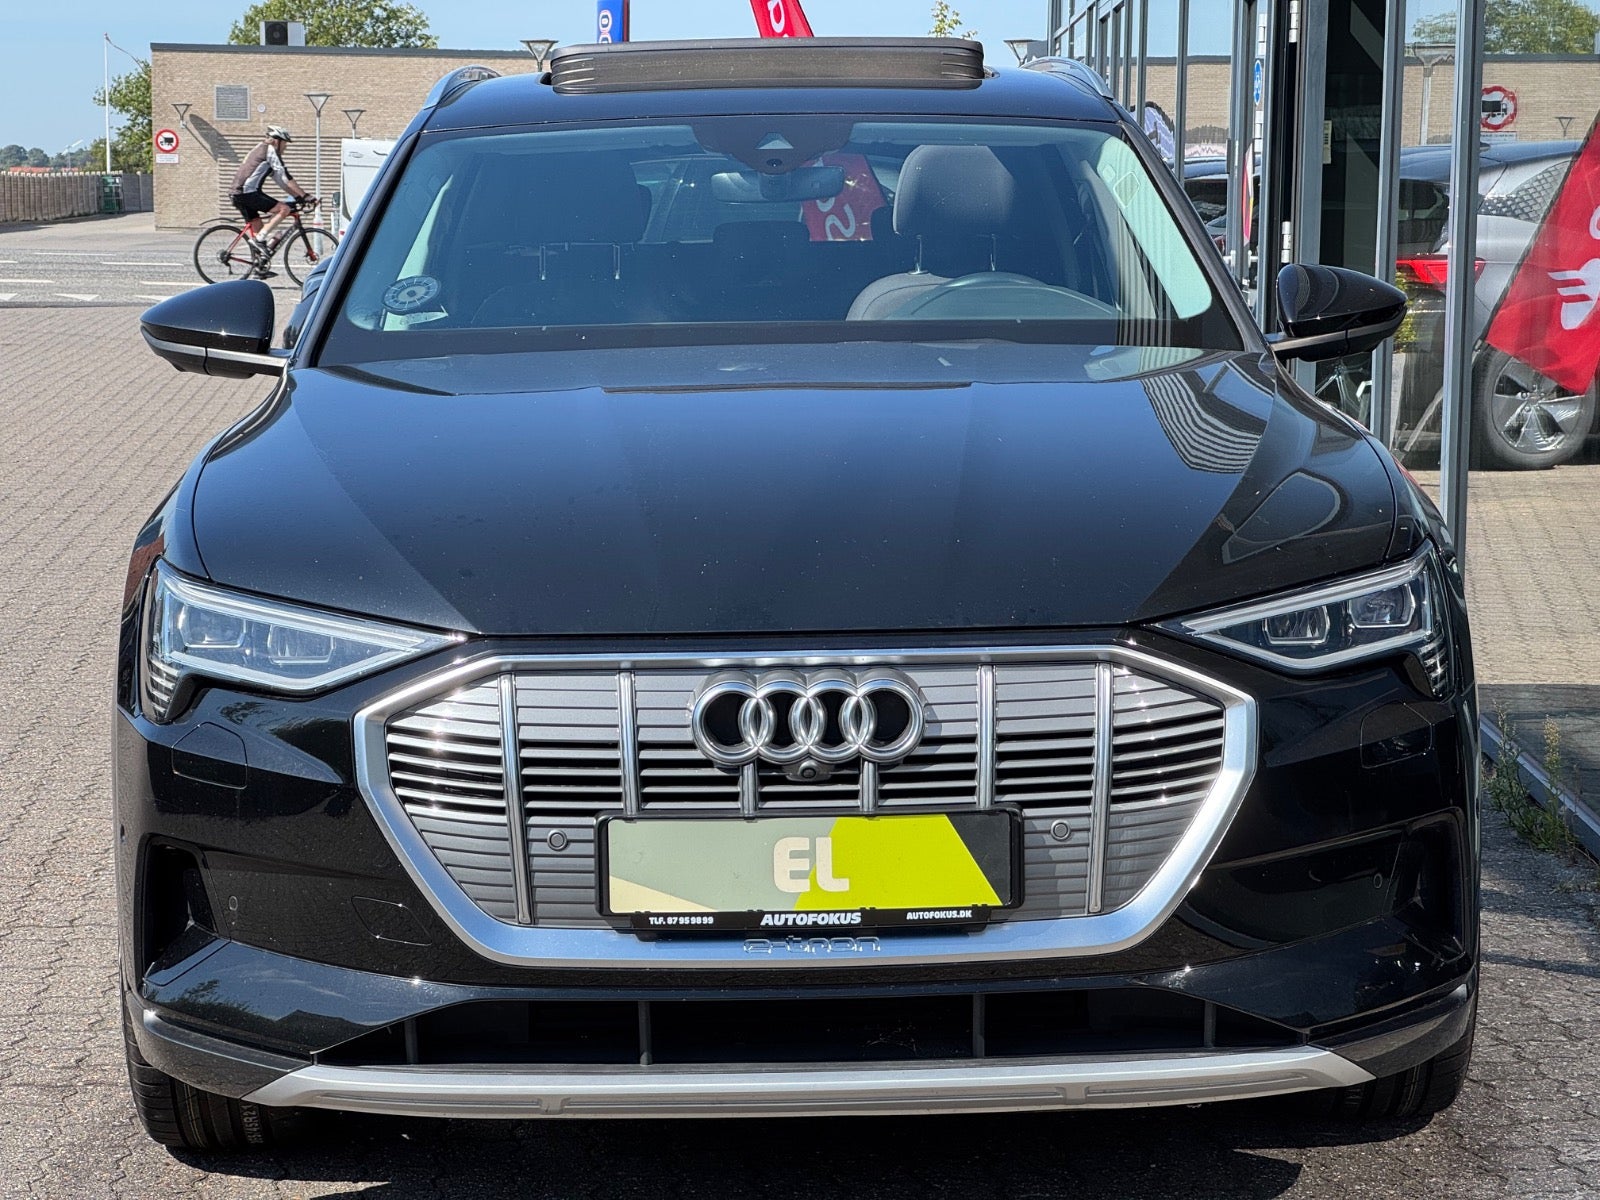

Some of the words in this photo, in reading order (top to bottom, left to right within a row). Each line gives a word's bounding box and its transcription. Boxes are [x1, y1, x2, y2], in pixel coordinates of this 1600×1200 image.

[774, 837, 849, 893] EL
[648, 916, 666, 925] TLF.
[760, 912, 861, 926] AUTOFOKUS
[906, 910, 972, 920] AUTOFOKUS.DK
[743, 935, 880, 954] e-tron
